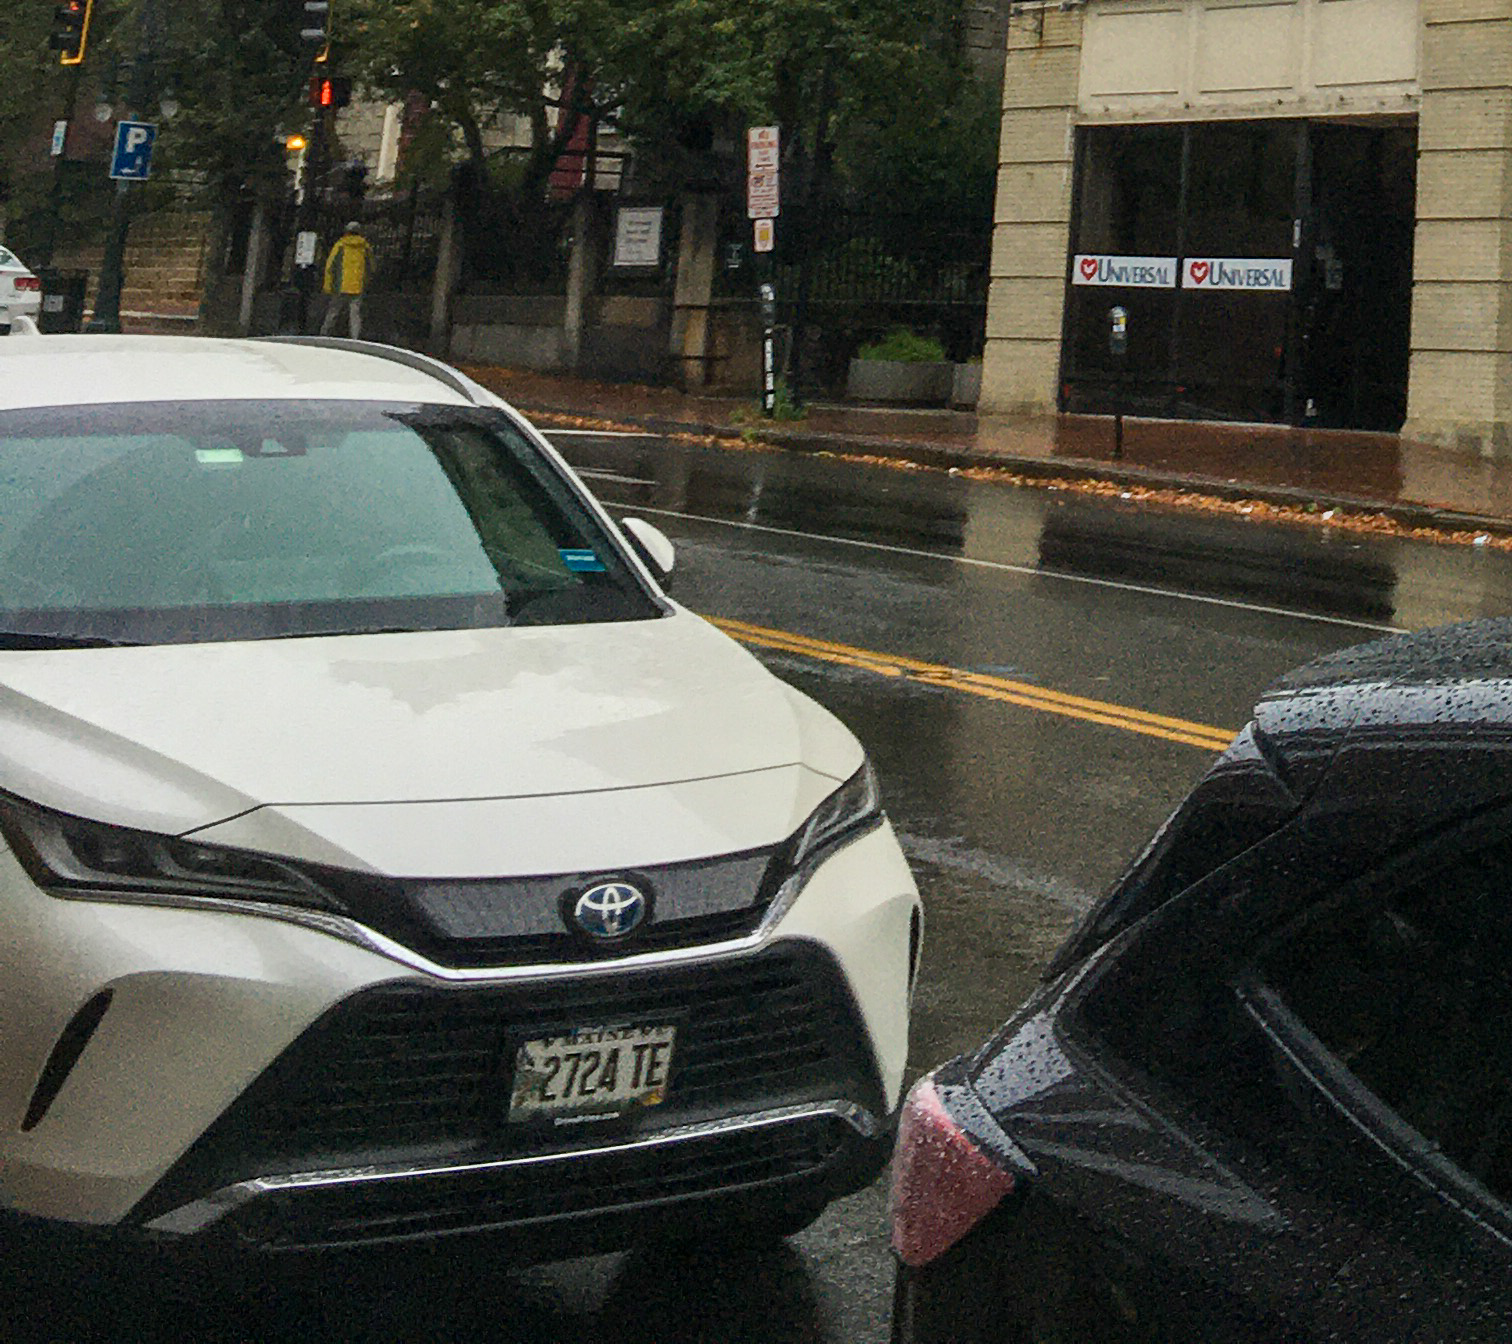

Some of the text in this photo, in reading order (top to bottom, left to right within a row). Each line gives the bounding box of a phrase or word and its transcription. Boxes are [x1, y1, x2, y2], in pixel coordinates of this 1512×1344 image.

[125, 127, 147, 153] P
[541, 1041, 670, 1102] 2724 TE
